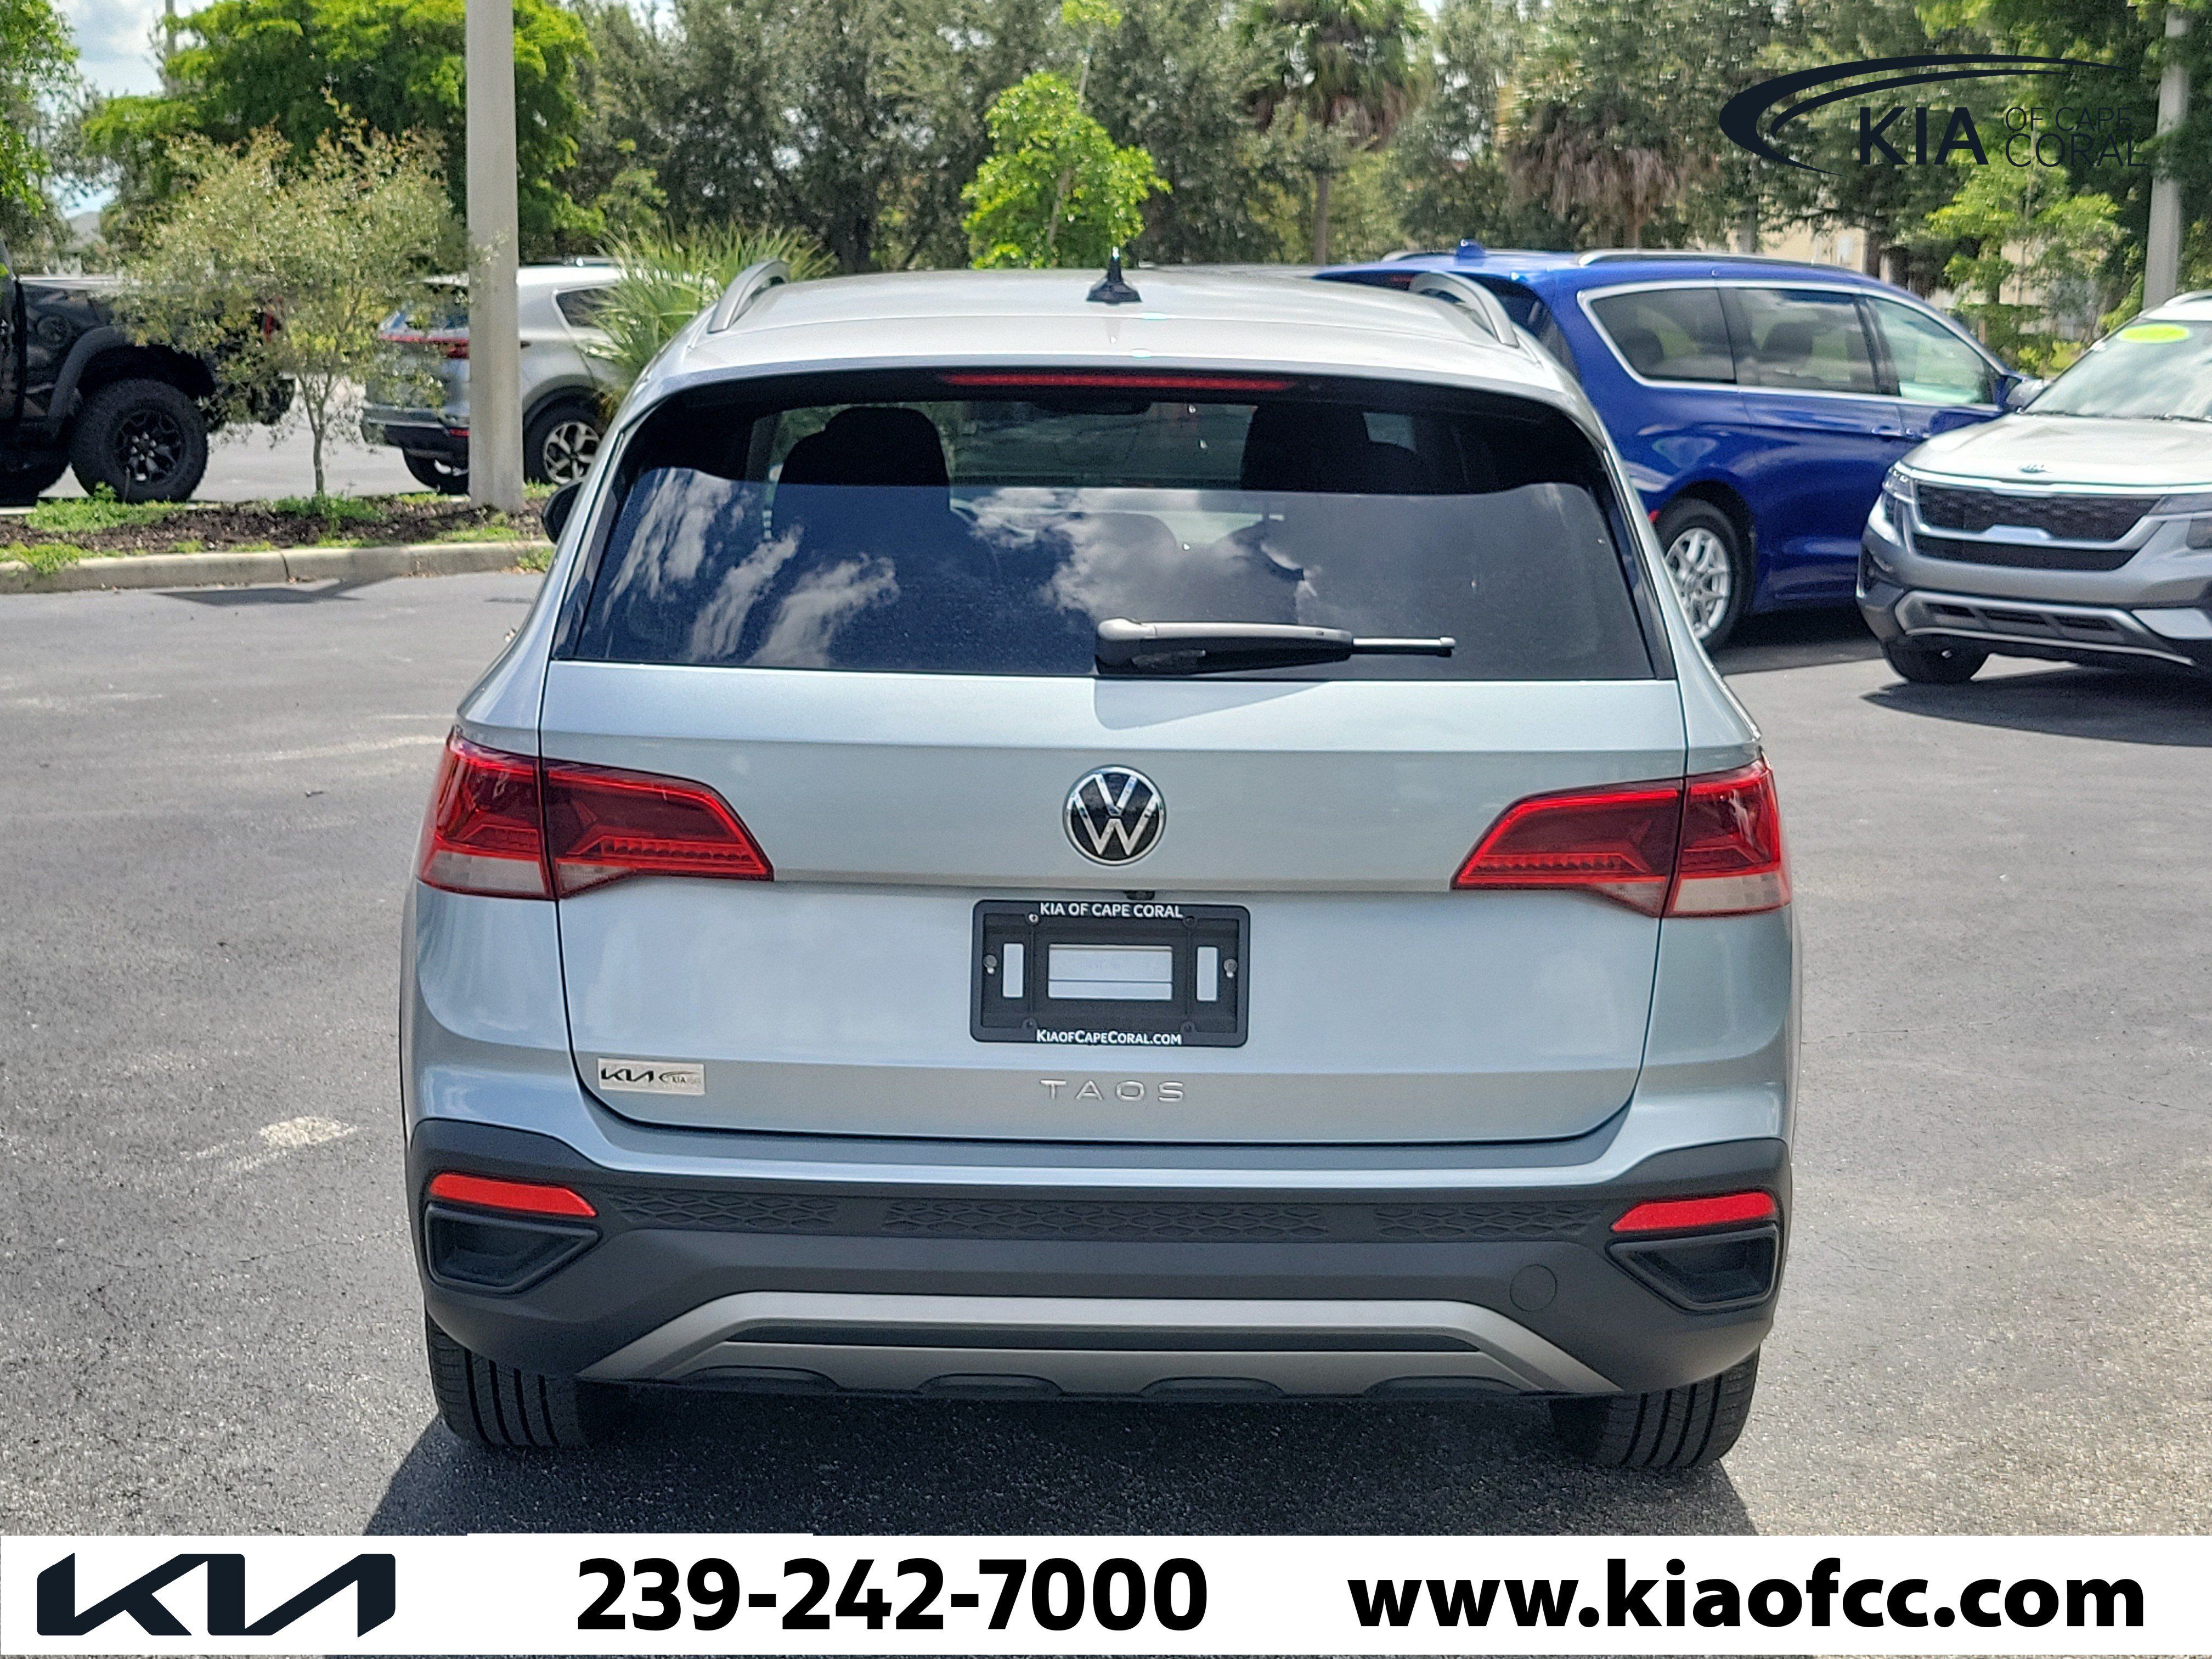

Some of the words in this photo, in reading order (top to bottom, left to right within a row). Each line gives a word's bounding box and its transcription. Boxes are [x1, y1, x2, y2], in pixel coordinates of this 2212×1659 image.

[1040, 902, 1065, 916] KIA
[1068, 902, 1090, 916] OF
[1092, 904, 1131, 917] CAPE
[1133, 904, 1184, 918] CORAL
[1040, 1079, 1184, 1102] TAOS
